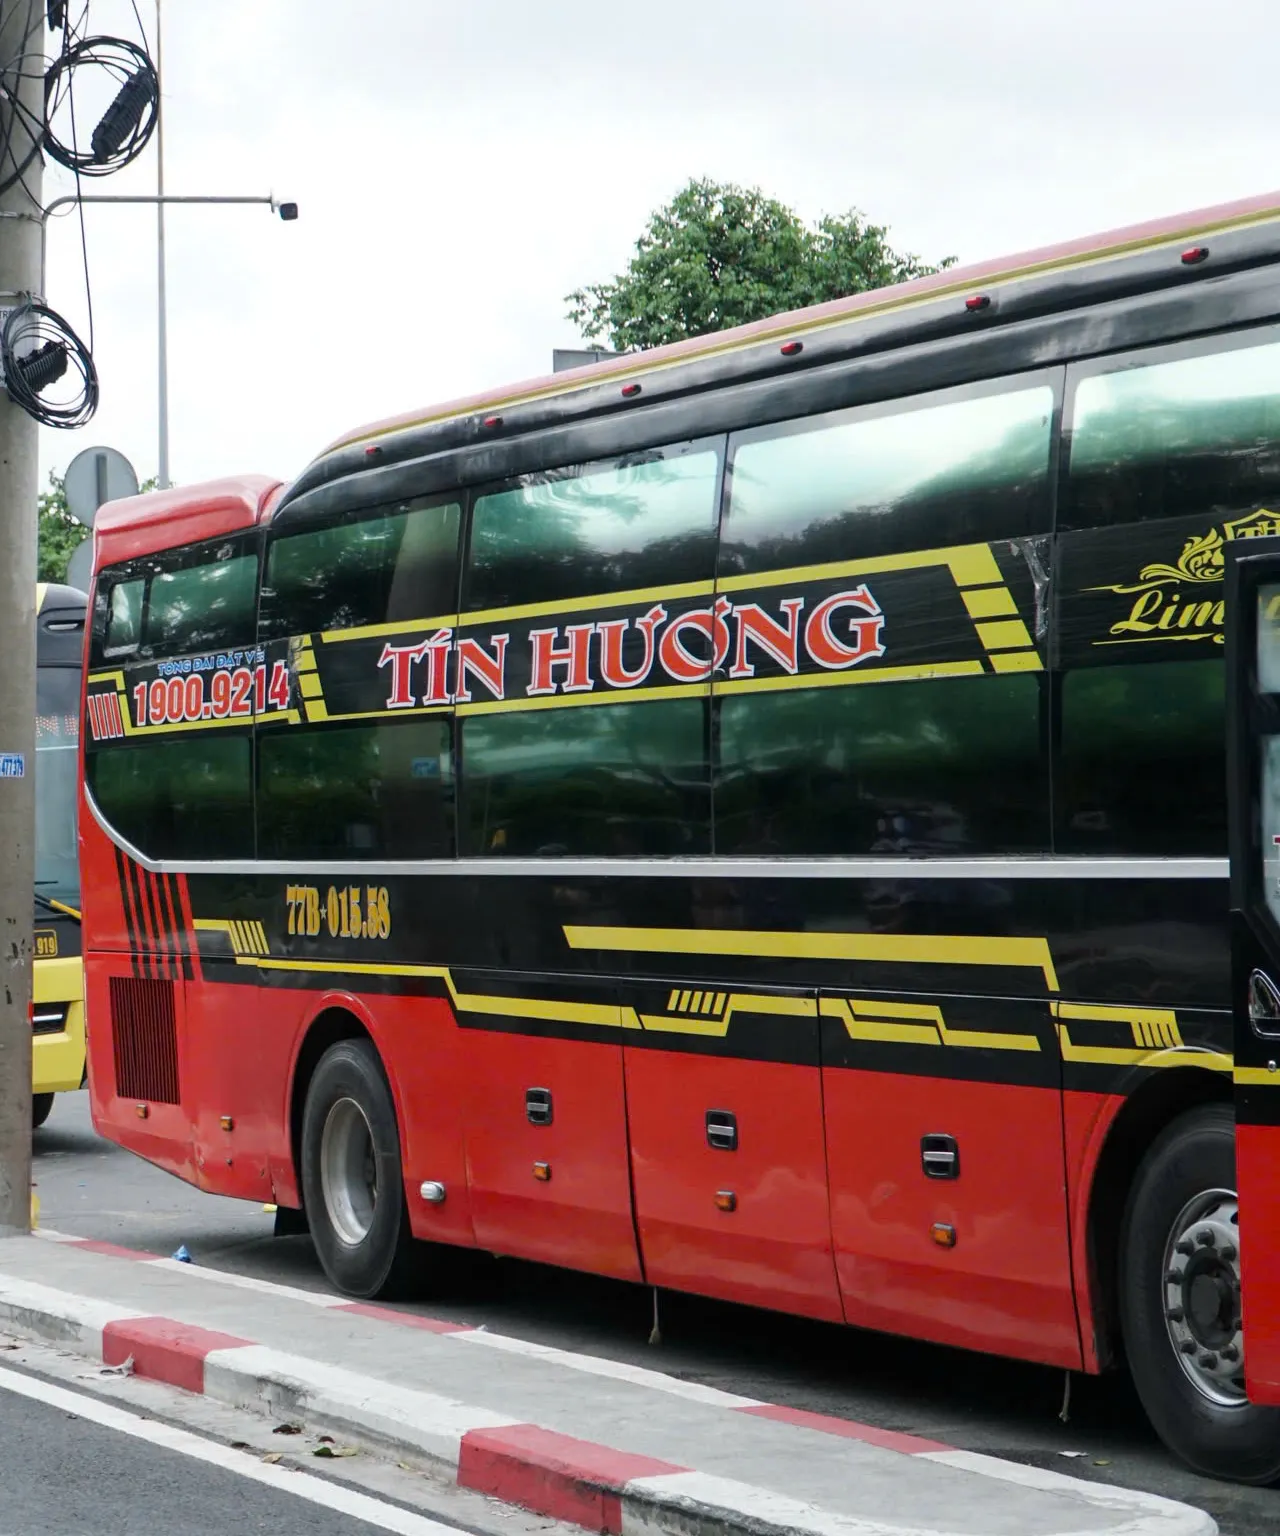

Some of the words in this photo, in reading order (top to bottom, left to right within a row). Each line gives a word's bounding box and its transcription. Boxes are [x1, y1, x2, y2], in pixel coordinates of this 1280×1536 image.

[377, 628, 510, 709] TÍN
[527, 584, 886, 695] HƯƠNG
[133, 659, 290, 727] 1900.9214
[286, 884, 320, 936] 77B
